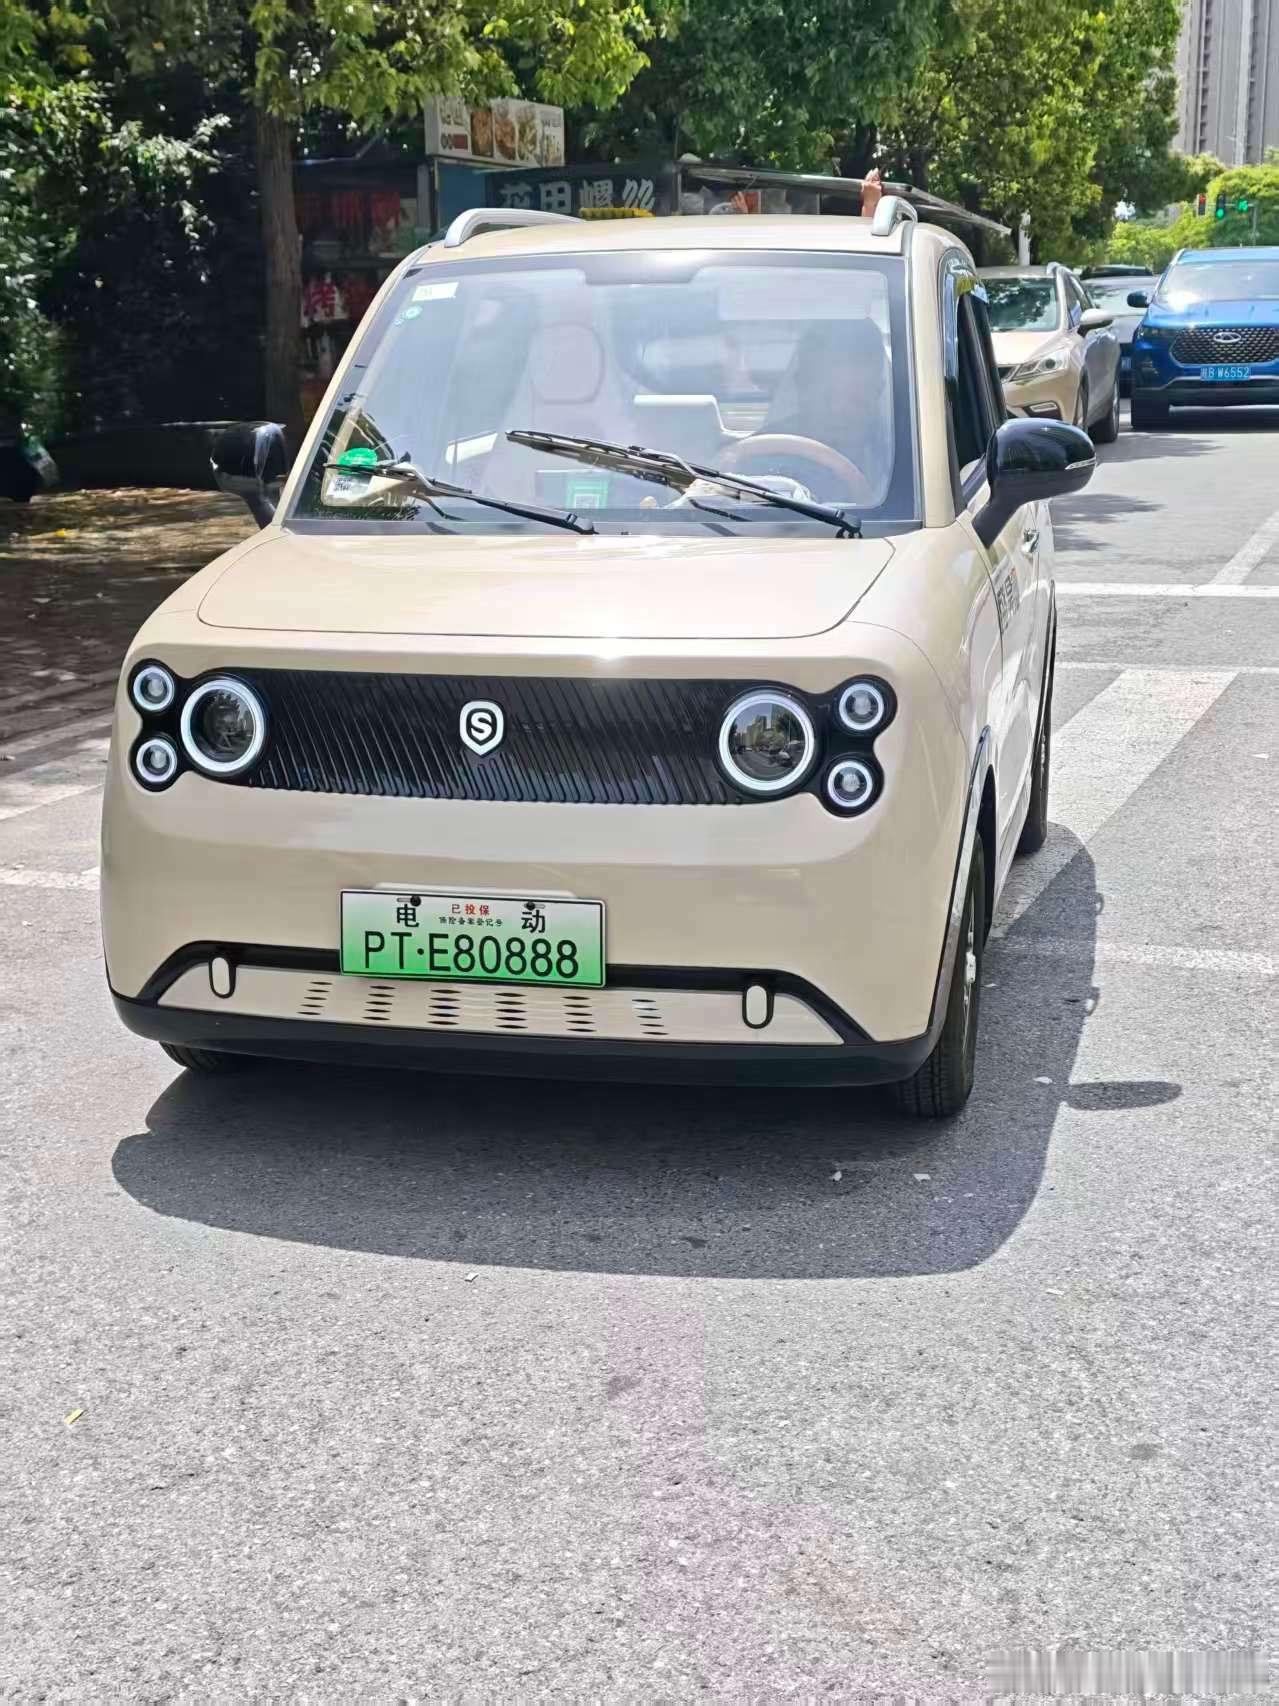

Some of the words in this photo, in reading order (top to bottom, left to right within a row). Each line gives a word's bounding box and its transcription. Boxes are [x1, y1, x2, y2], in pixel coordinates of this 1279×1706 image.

[396, 904, 420, 928] 电
[521, 909, 547, 934] 动
[451, 903, 490, 916] 已投保
[364, 930, 579, 978] PT·E80888
